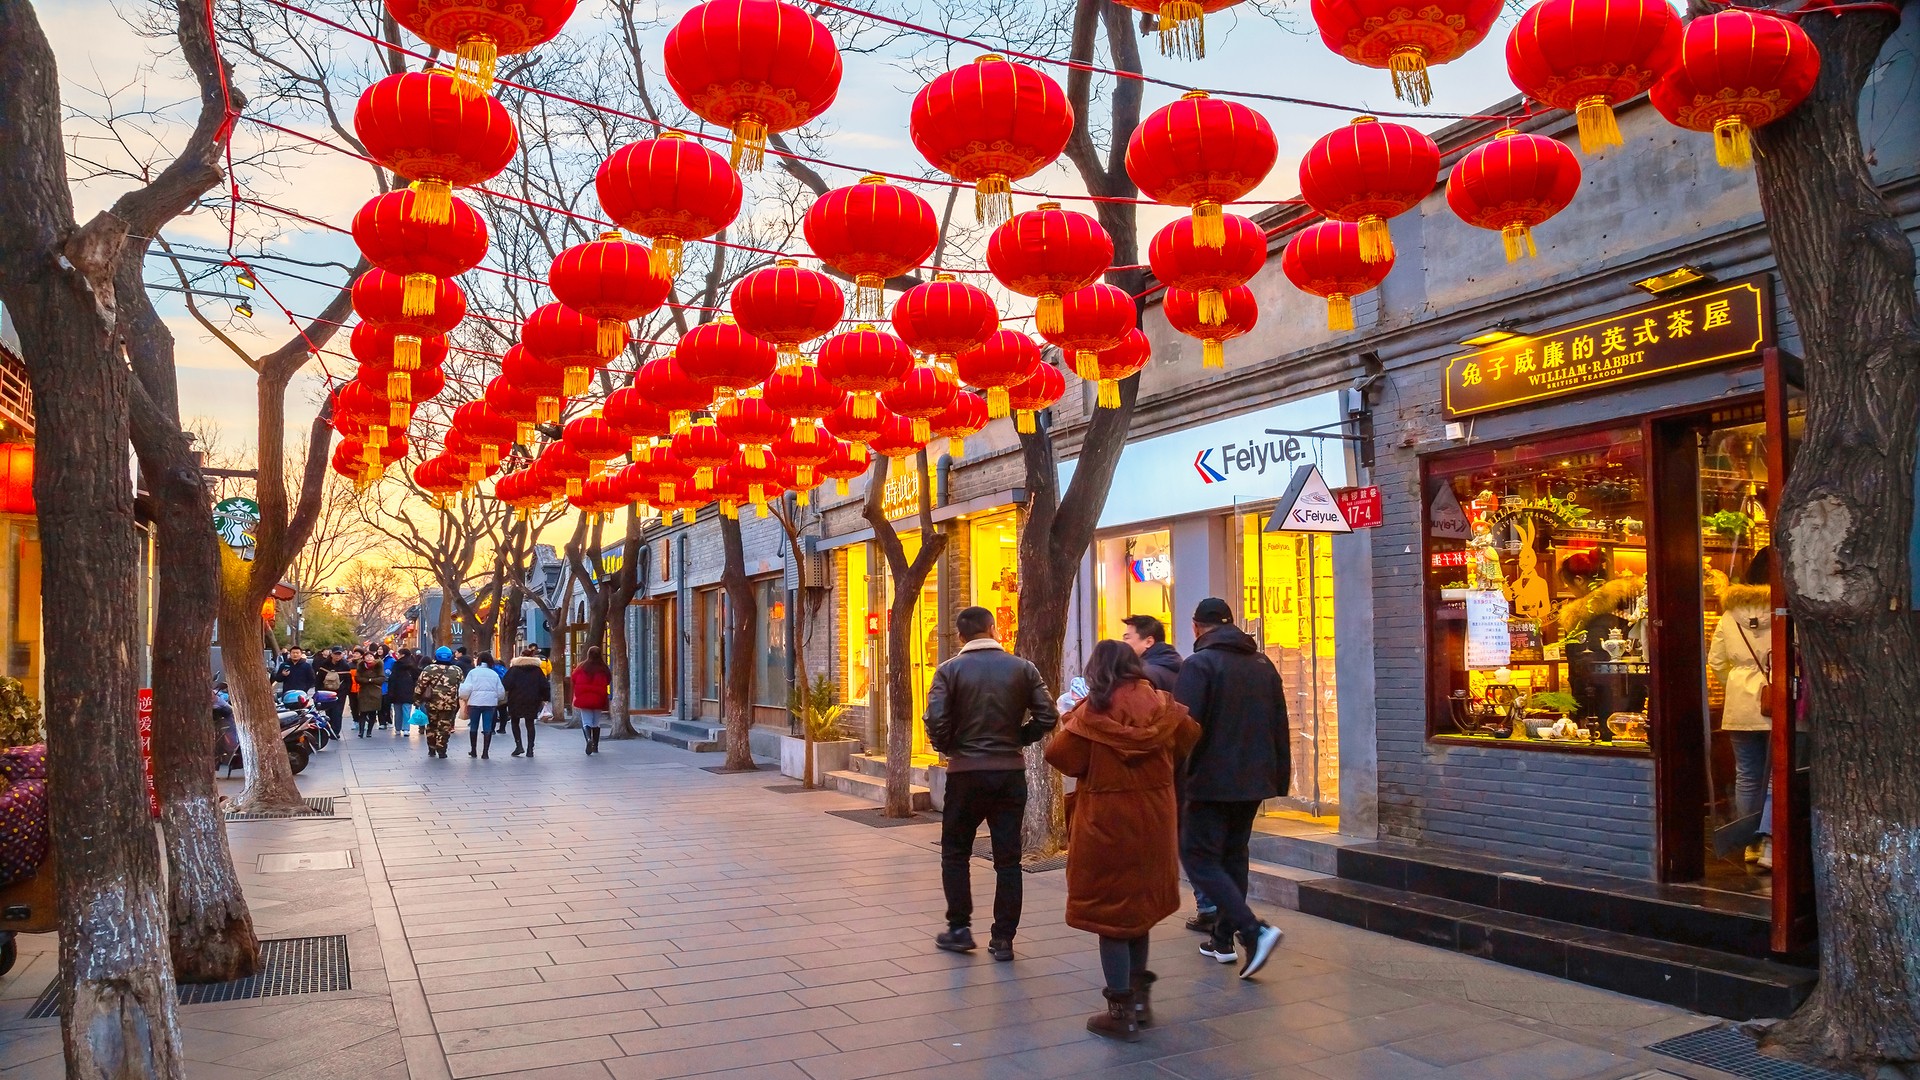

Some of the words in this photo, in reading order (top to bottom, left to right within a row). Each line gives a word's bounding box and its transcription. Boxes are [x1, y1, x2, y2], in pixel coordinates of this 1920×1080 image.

[1461, 299, 1732, 388] 兔子威廉的英式茶屋
[1547, 377, 1579, 390] BRITISH
[1582, 367, 1624, 383] TEAROOM
[1222, 435, 1306, 476] Feiyue.
[1305, 509, 1339, 524] Feiyue.
[1347, 505, 1372, 525] 17-4
